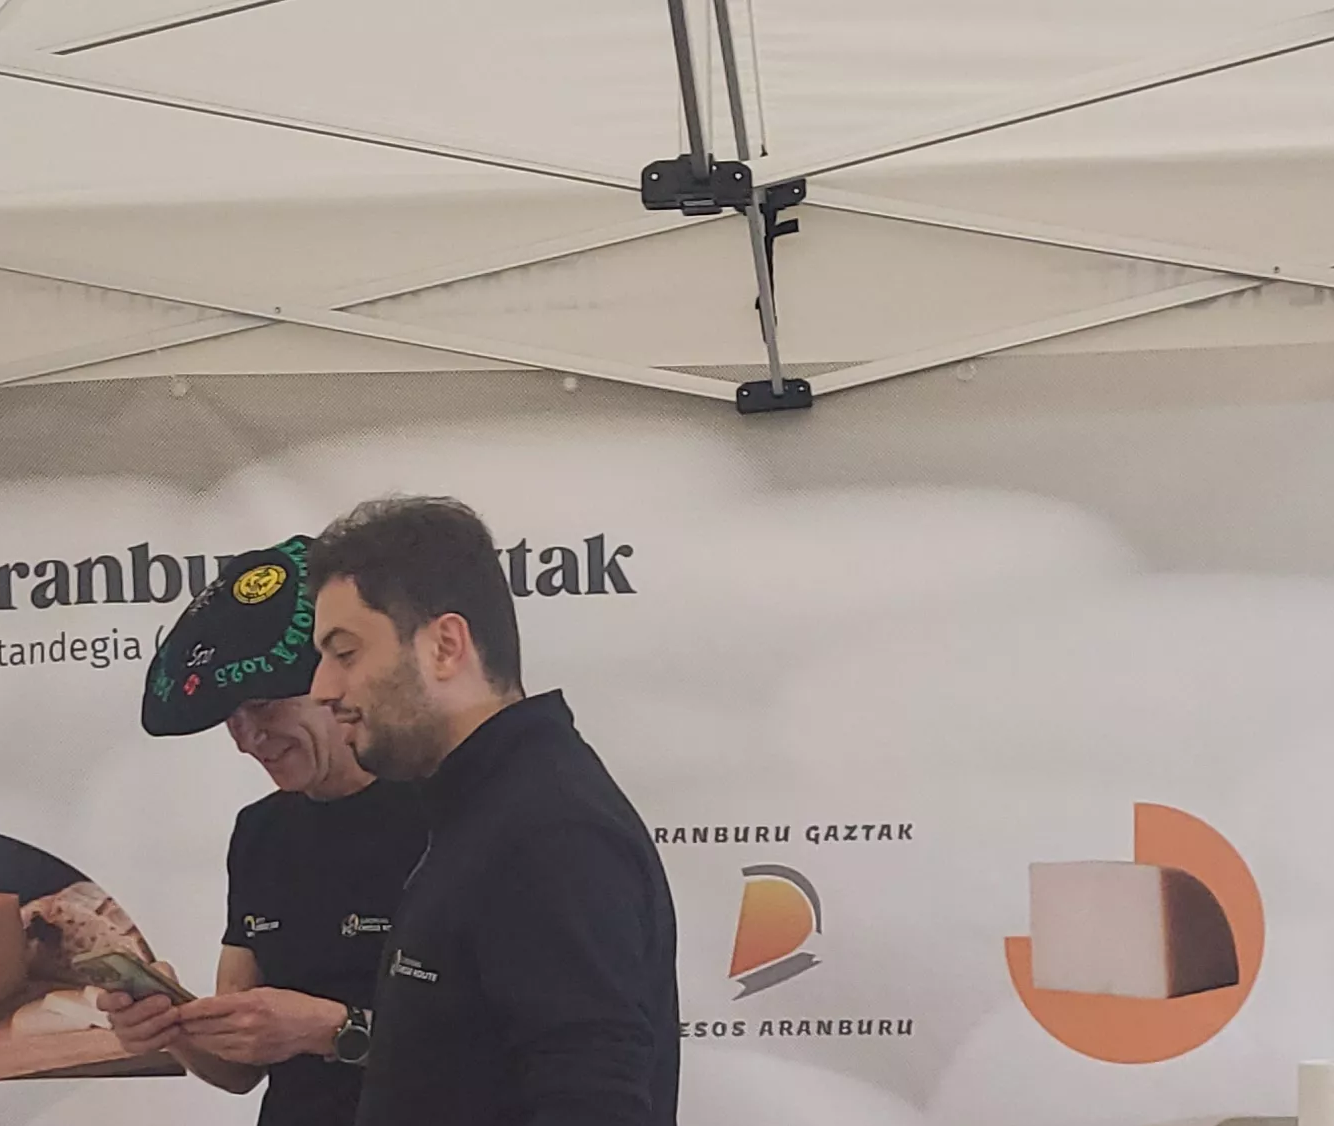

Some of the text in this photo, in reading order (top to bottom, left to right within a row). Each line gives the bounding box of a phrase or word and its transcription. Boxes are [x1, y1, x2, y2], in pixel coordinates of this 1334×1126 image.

[503, 532, 638, 599] tak
[654, 823, 913, 845] RANBURU GAZTAK
[679, 1019, 914, 1038] ESOS ARANBURU
